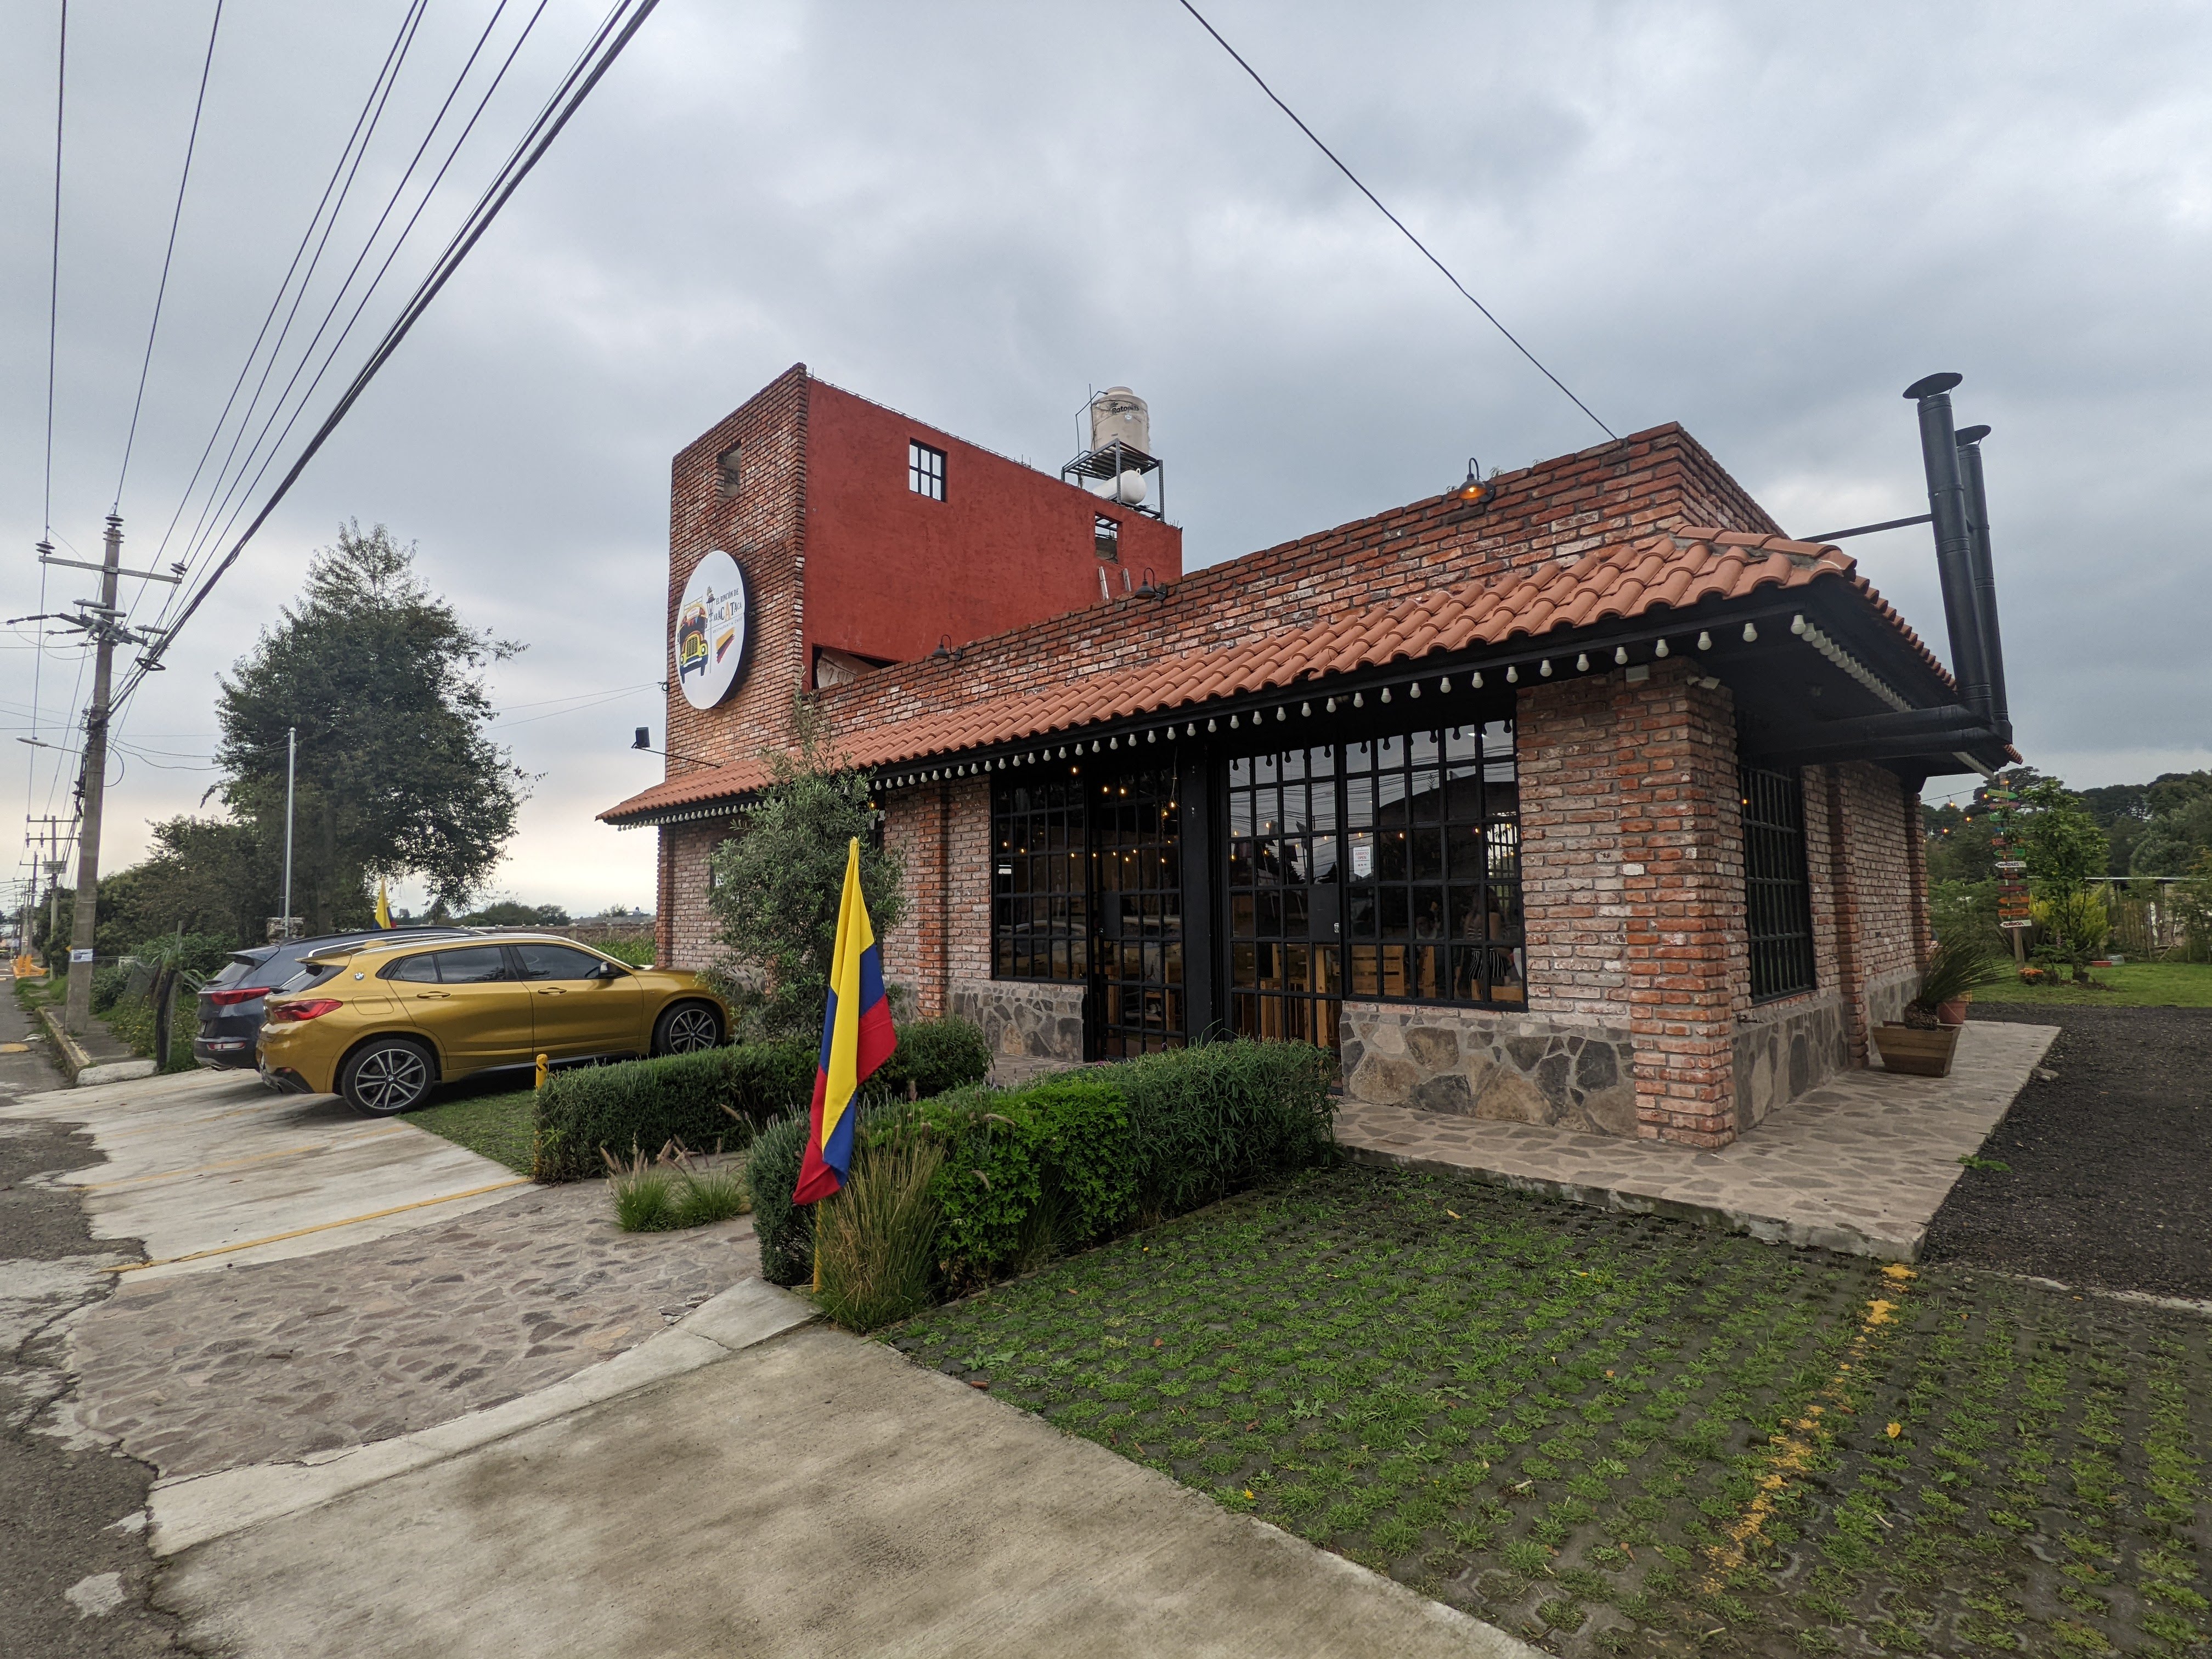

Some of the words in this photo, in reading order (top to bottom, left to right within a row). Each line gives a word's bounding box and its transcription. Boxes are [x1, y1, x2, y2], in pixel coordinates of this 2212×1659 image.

[1112, 404, 1139, 415] Rotoplas
[720, 590, 733, 603] RINCÓN
[733, 588, 739, 596] DE
